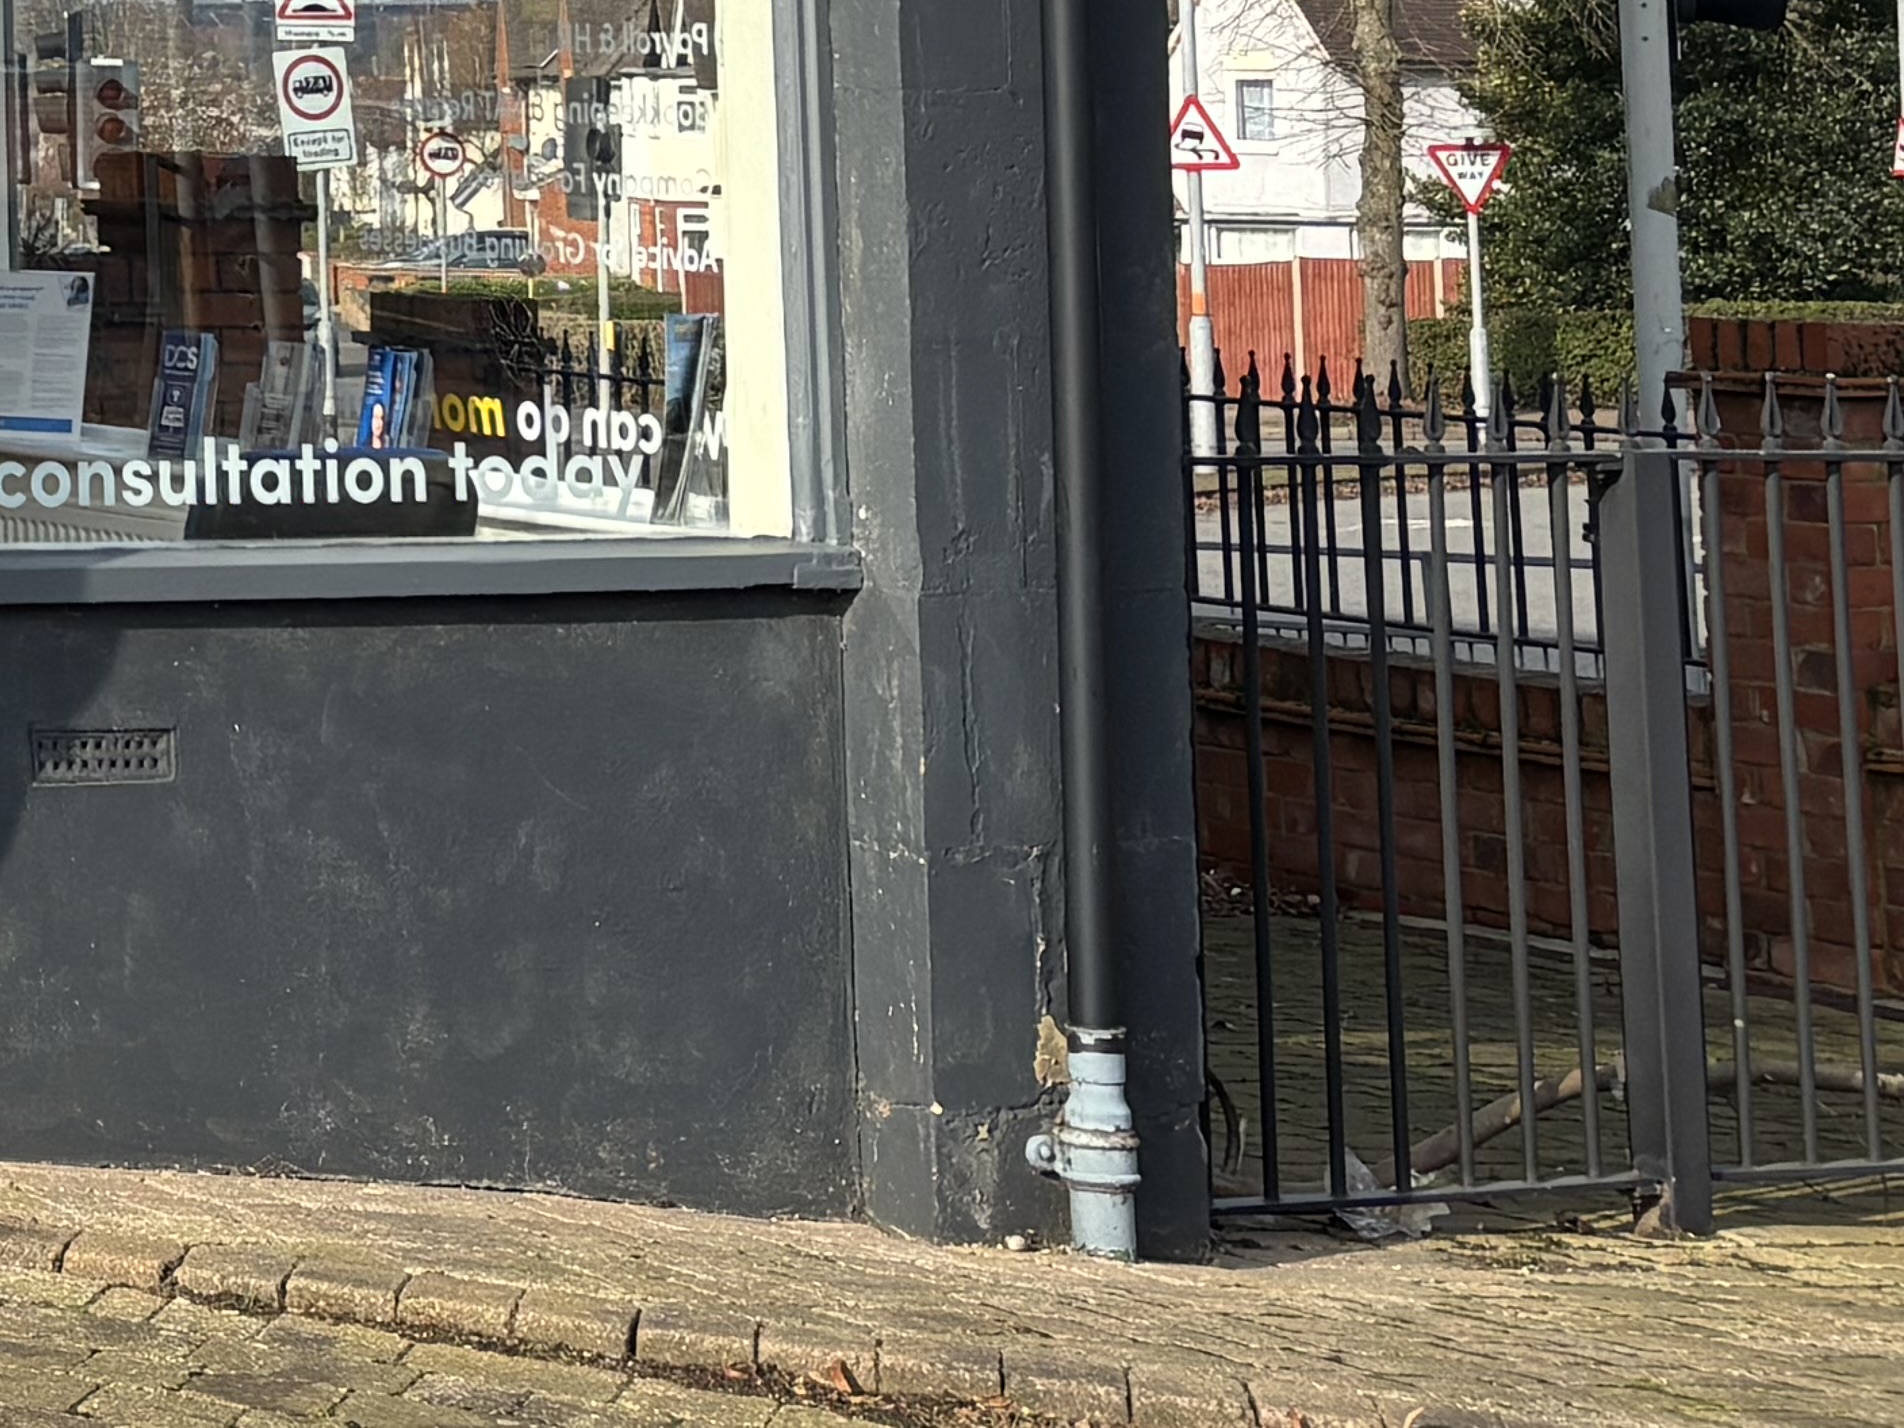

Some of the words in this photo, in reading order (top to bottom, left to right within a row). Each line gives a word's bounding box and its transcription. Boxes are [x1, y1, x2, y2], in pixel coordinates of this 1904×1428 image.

[1446, 152, 1491, 166] GIVE
[1457, 170, 1484, 180] WAY
[448, 441, 643, 519] today
